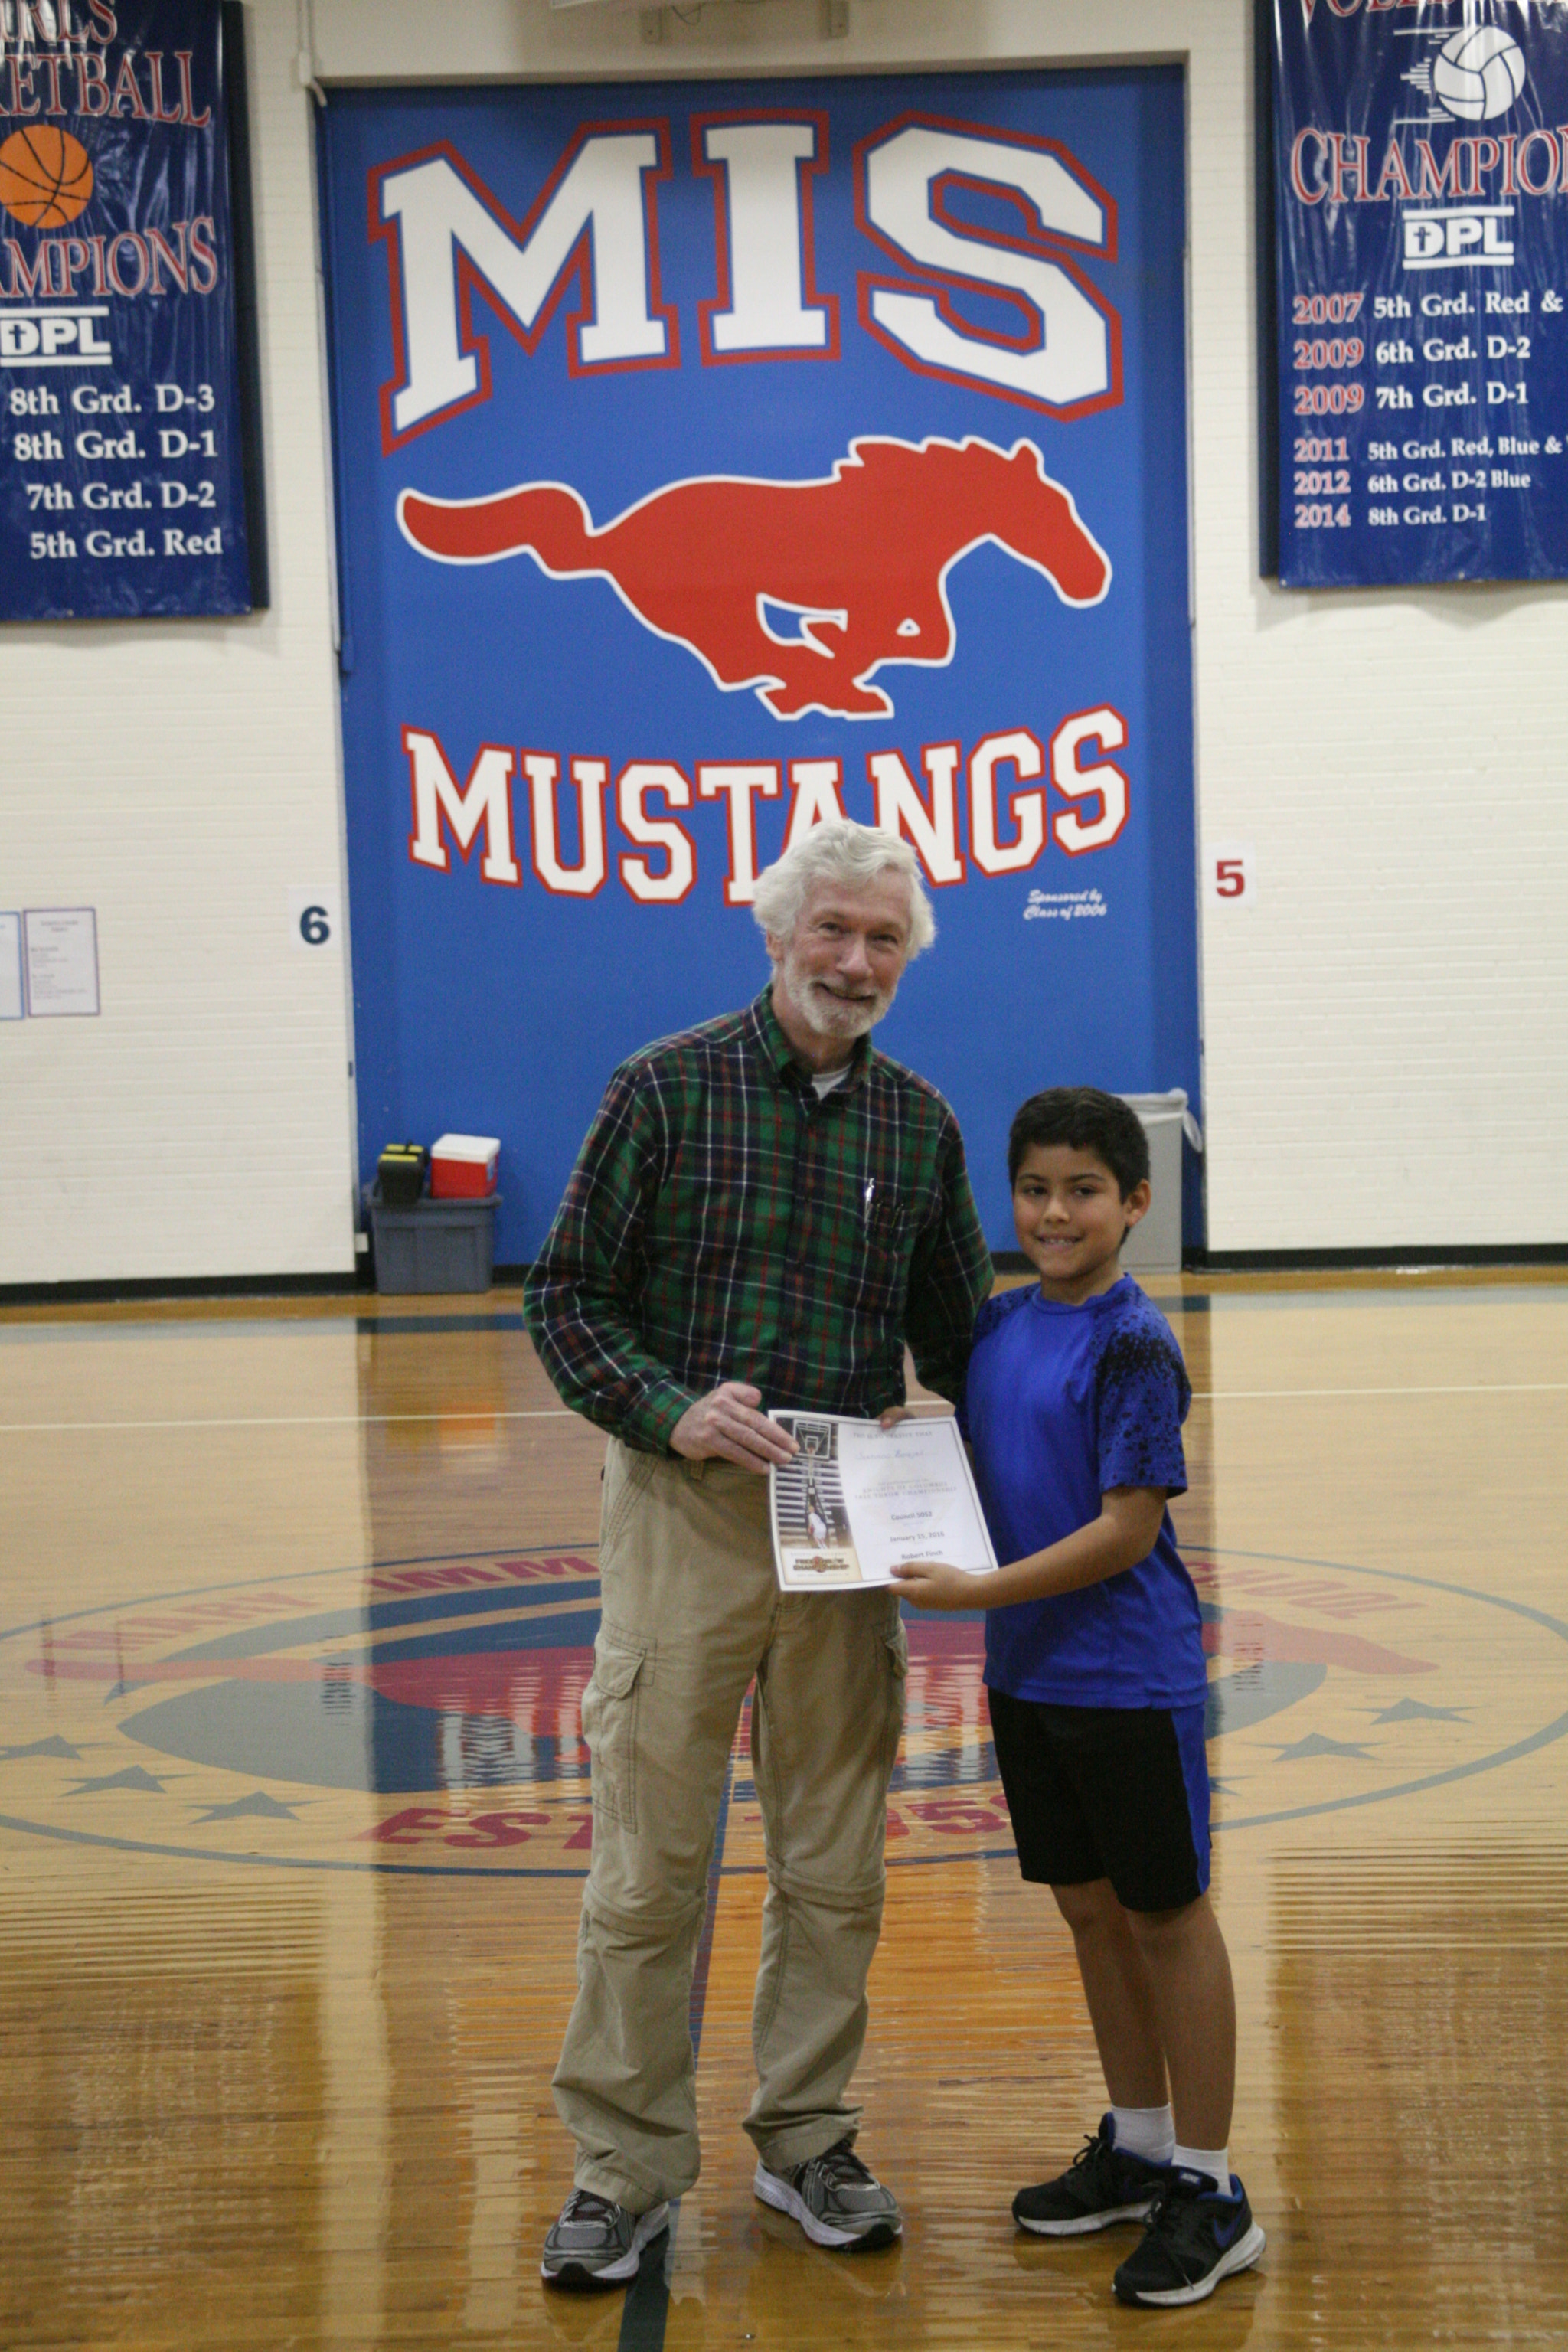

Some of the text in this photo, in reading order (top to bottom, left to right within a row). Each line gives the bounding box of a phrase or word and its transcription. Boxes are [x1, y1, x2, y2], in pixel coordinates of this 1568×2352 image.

[0, 51, 211, 128] ETBALL
[1403, 217, 1515, 259] DPL
[0, 217, 218, 299] AMPIONS
[368, 109, 1124, 458] MIS
[1292, 289, 1564, 325] 2007 5th Grd. Red &
[0, 318, 112, 355] DPL
[1293, 335, 1531, 370] 2009 6th Grd. D-2
[10, 384, 215, 415] 8th Grd. D-3
[1294, 381, 1529, 416] 2009 7th Grd. D-1
[14, 430, 218, 461] 8th Grd. D-1
[1294, 436, 1563, 463] 2011 5th Grd. Red, Blue &
[26, 481, 217, 511] 7th Grd. D-2
[1294, 469, 1531, 495] 2012 6th Grd. D-2 Blue
[1295, 503, 1487, 528] 2014 8th Grd. D-1
[30, 527, 224, 560] 5th Grd. Red
[401, 704, 1130, 906] MUSTANGS
[1216, 859, 1245, 897] 5
[1023, 904, 1058, 920] Class
[1060, 904, 1073, 921] of
[1027, 888, 1102, 904] Sponsored by
[300, 906, 330, 946] 6
[890, 1512, 916, 1521] Council
